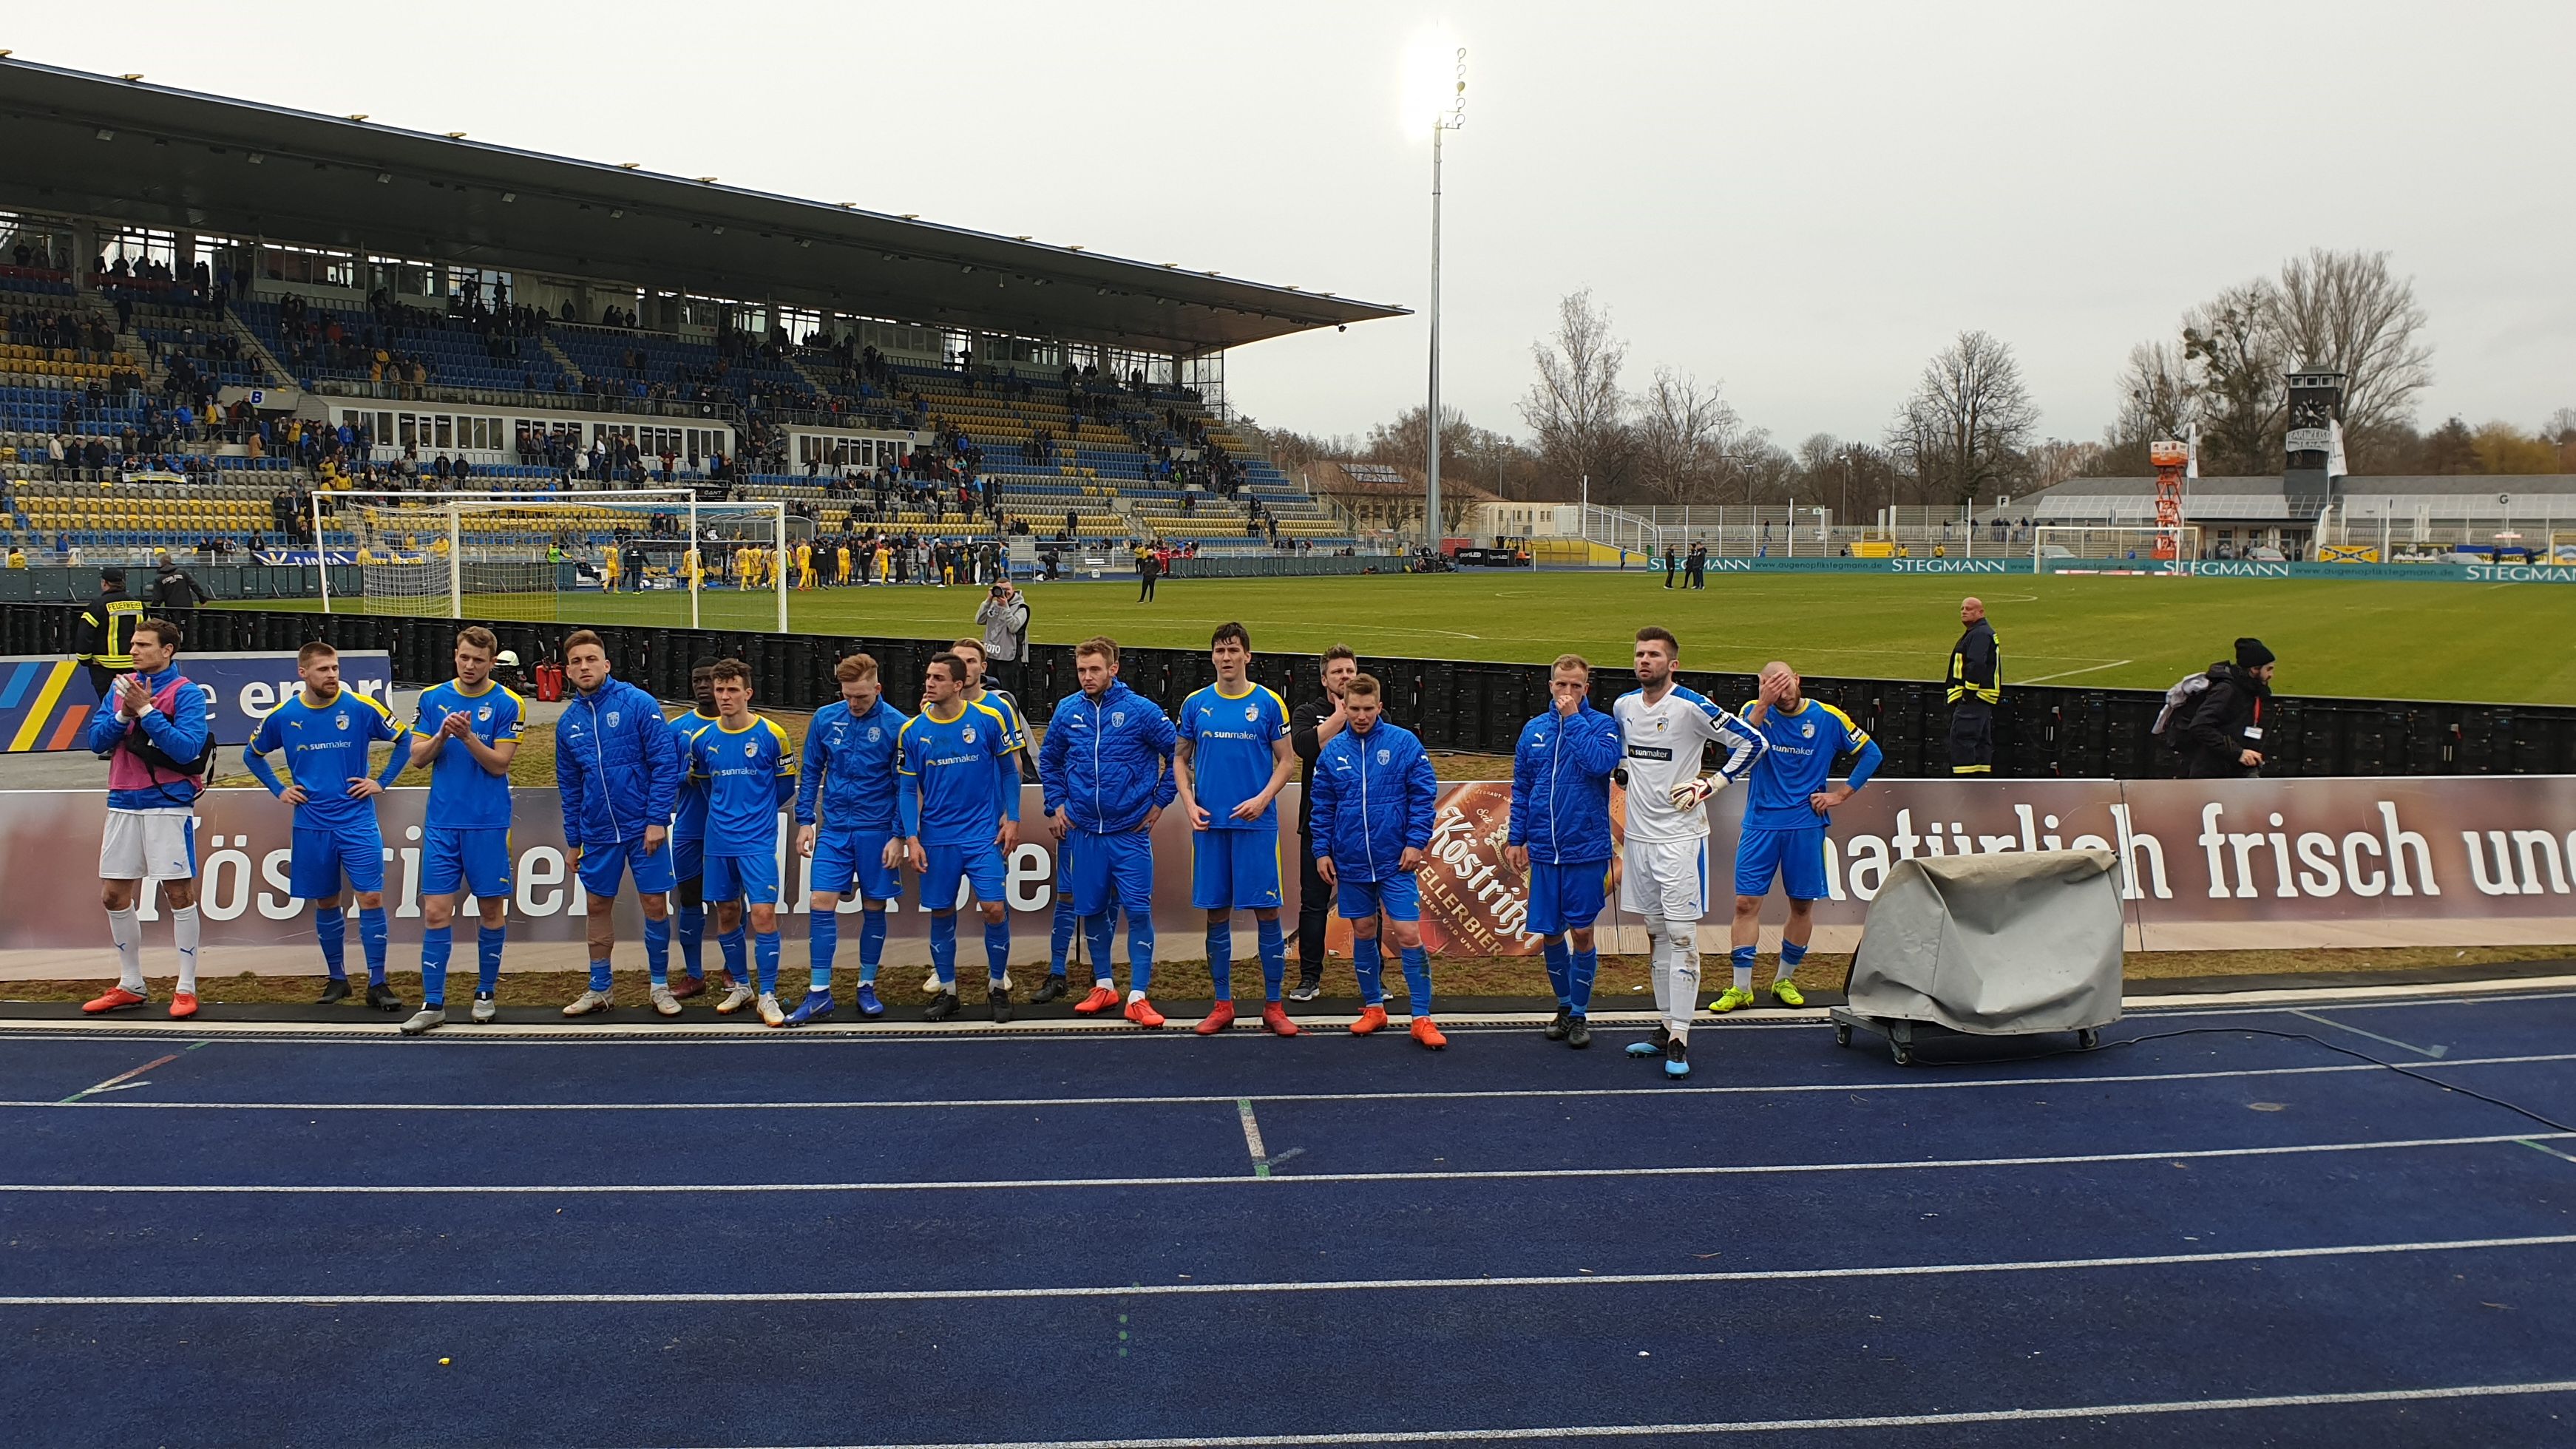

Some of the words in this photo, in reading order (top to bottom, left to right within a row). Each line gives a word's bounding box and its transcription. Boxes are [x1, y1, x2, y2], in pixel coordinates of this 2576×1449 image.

[251, 391, 262, 404] B
[2499, 495, 2509, 504] G
[1755, 561, 1882, 570] www.augenoptikstegmann.de
[1892, 559, 2005, 572] STEGMANN
[2163, 560, 2289, 576] STEGMANN
[2466, 565, 2576, 581] STEGMA
[1214, 731, 1257, 740] sunmaker
[310, 739, 352, 750] sunmaker
[1772, 744, 1814, 756] sunmaker
[1635, 749, 1668, 758] sunmaker
[938, 754, 980, 766] sunmaker
[721, 767, 758, 776] sunmaker
[1476, 808, 1494, 824] Seit
[2198, 801, 2441, 898] frisch
[2461, 829, 2576, 896] un
[1419, 860, 1505, 956] ELLERBIER
[1442, 917, 1459, 936] UND
